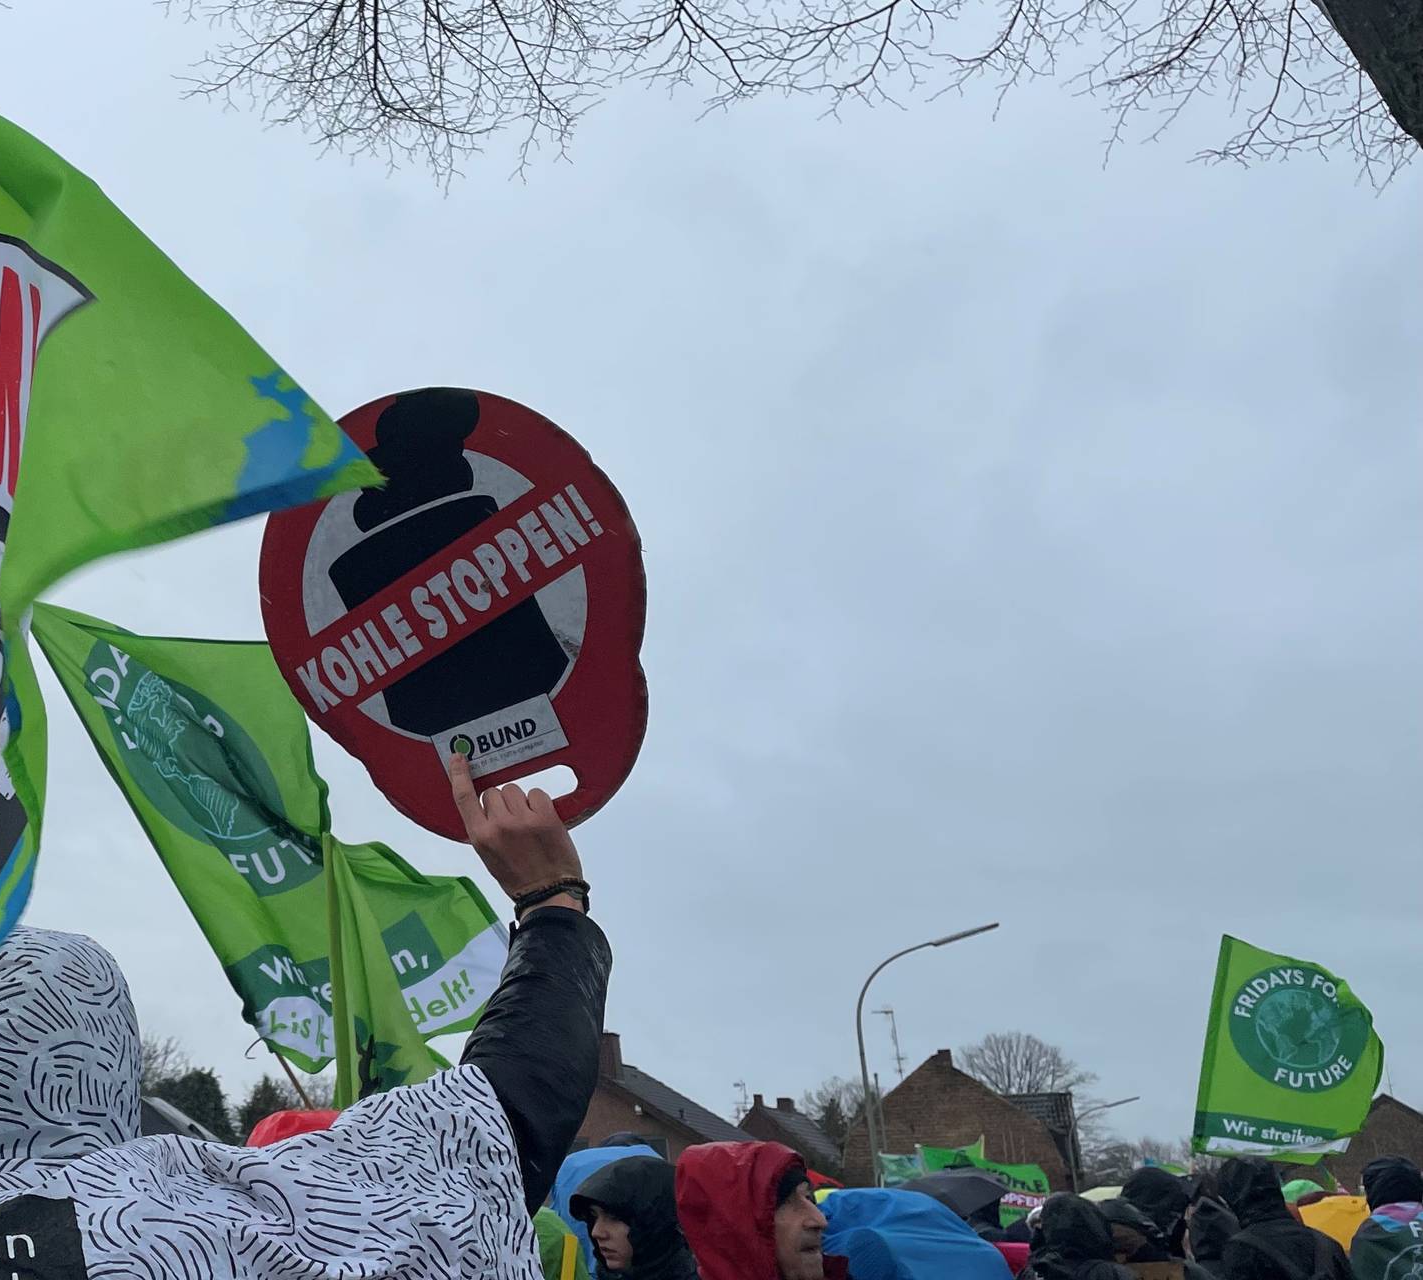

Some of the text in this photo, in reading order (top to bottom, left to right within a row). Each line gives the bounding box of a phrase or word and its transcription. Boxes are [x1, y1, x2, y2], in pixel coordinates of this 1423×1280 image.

[295, 603, 425, 714] KOHLE
[409, 483, 605, 641] STOPPEN!
[475, 718, 537, 754] BUND
[228, 838, 315, 885] FUT
[1233, 968, 1341, 1018] FRIDAYS FO
[1273, 1054, 1353, 1089] FUTURE
[1222, 1118, 1257, 1137] Wir
